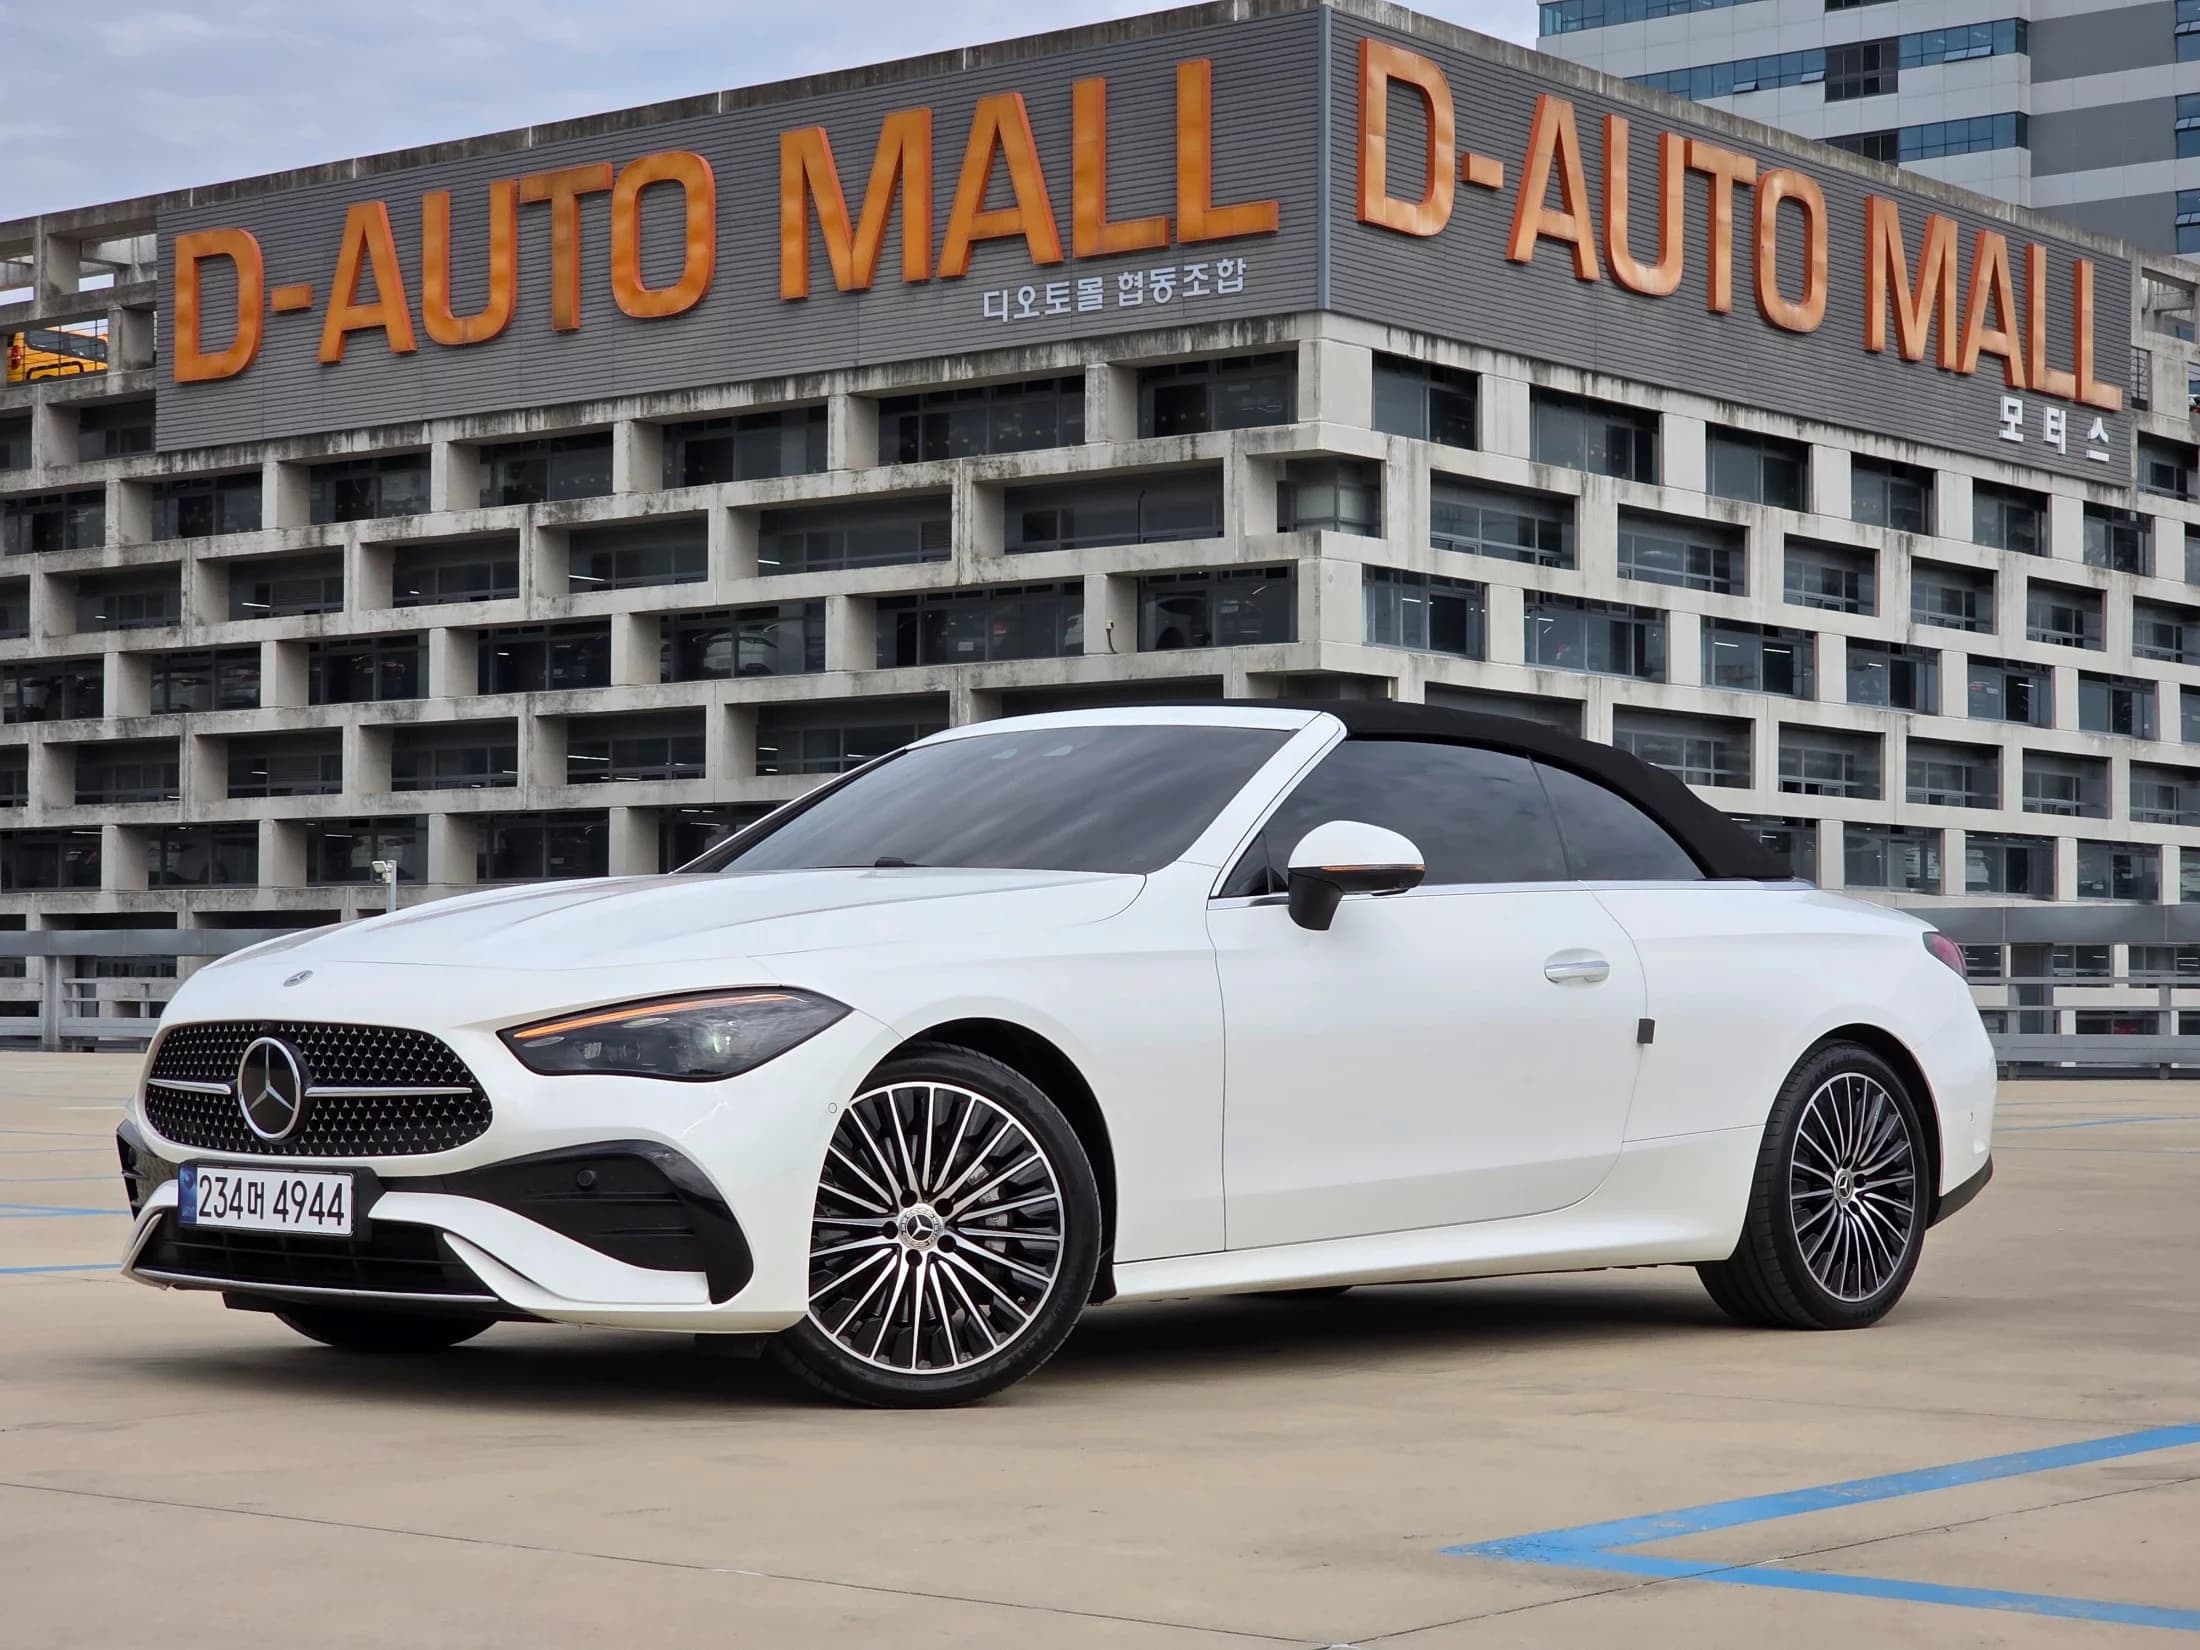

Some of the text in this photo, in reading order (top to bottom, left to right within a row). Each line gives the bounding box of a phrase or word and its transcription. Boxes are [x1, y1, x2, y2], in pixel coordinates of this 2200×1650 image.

[173, 57, 1280, 383] D-AUTO MALL
[1356, 37, 2123, 411] D-AUTO MALL
[983, 257, 1247, 323] 디오토몰 협동조합
[1999, 395, 2110, 462] 모터스
[199, 1174, 345, 1226] 234머 4944
